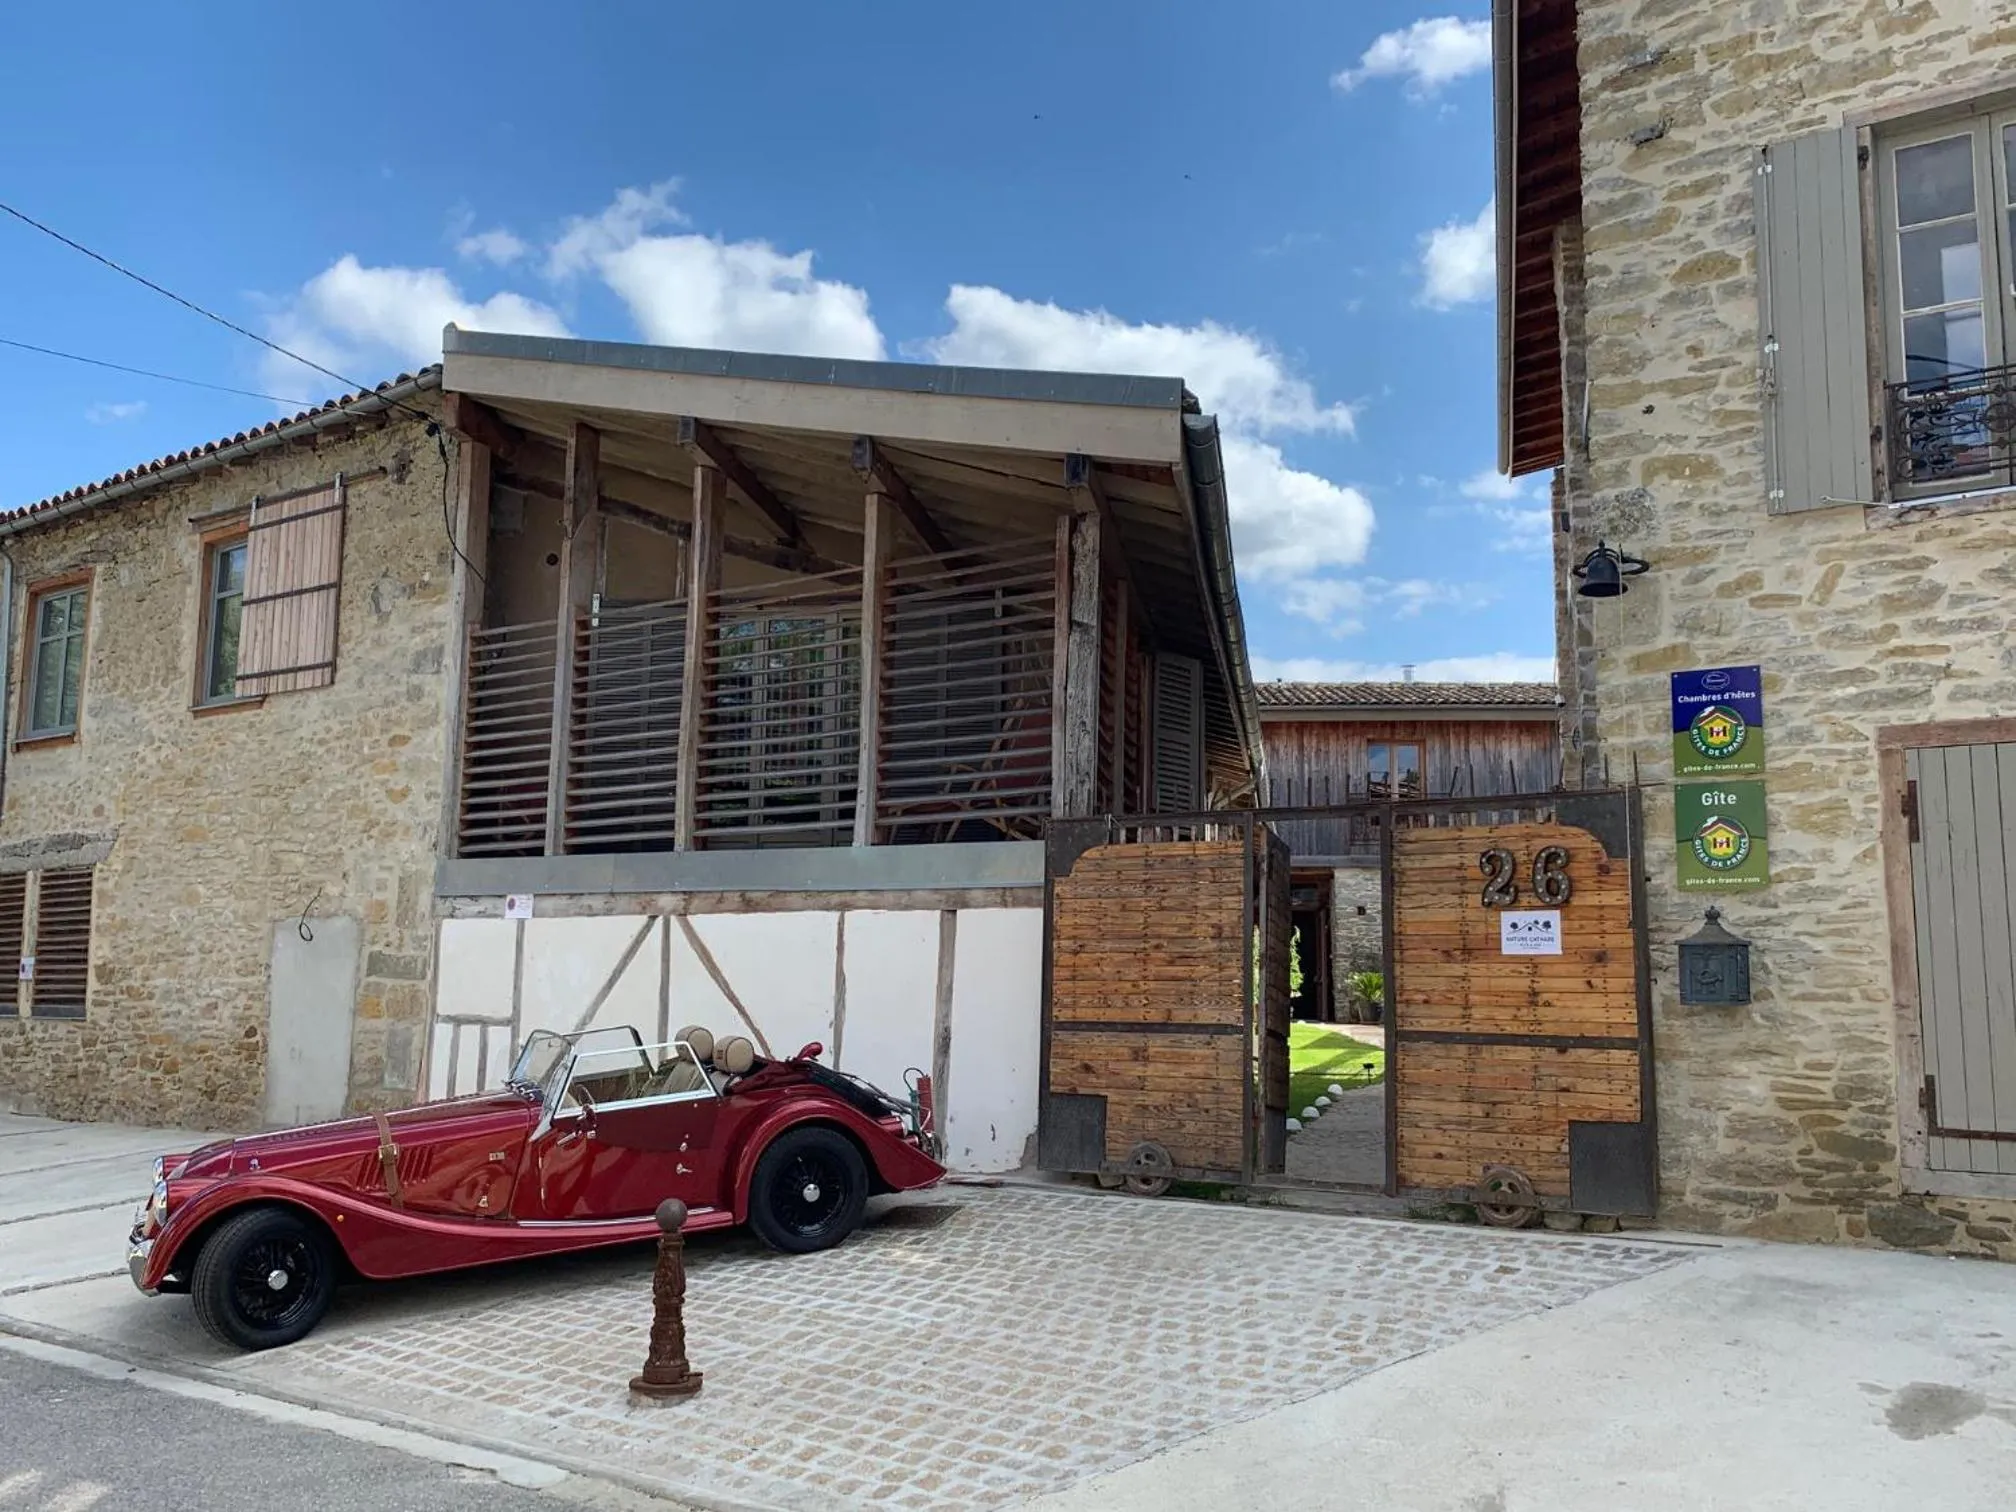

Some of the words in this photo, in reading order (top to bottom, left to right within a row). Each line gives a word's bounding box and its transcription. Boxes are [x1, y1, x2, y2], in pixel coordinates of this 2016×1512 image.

[1678, 693, 1722, 703] Chambres
[1723, 690, 1756, 700] d'hôtes
[1723, 726, 1745, 754] FRANCE
[1701, 790, 1737, 806] Gîte
[1726, 838, 1748, 866] FRANCE
[1480, 846, 1572, 908] 26
